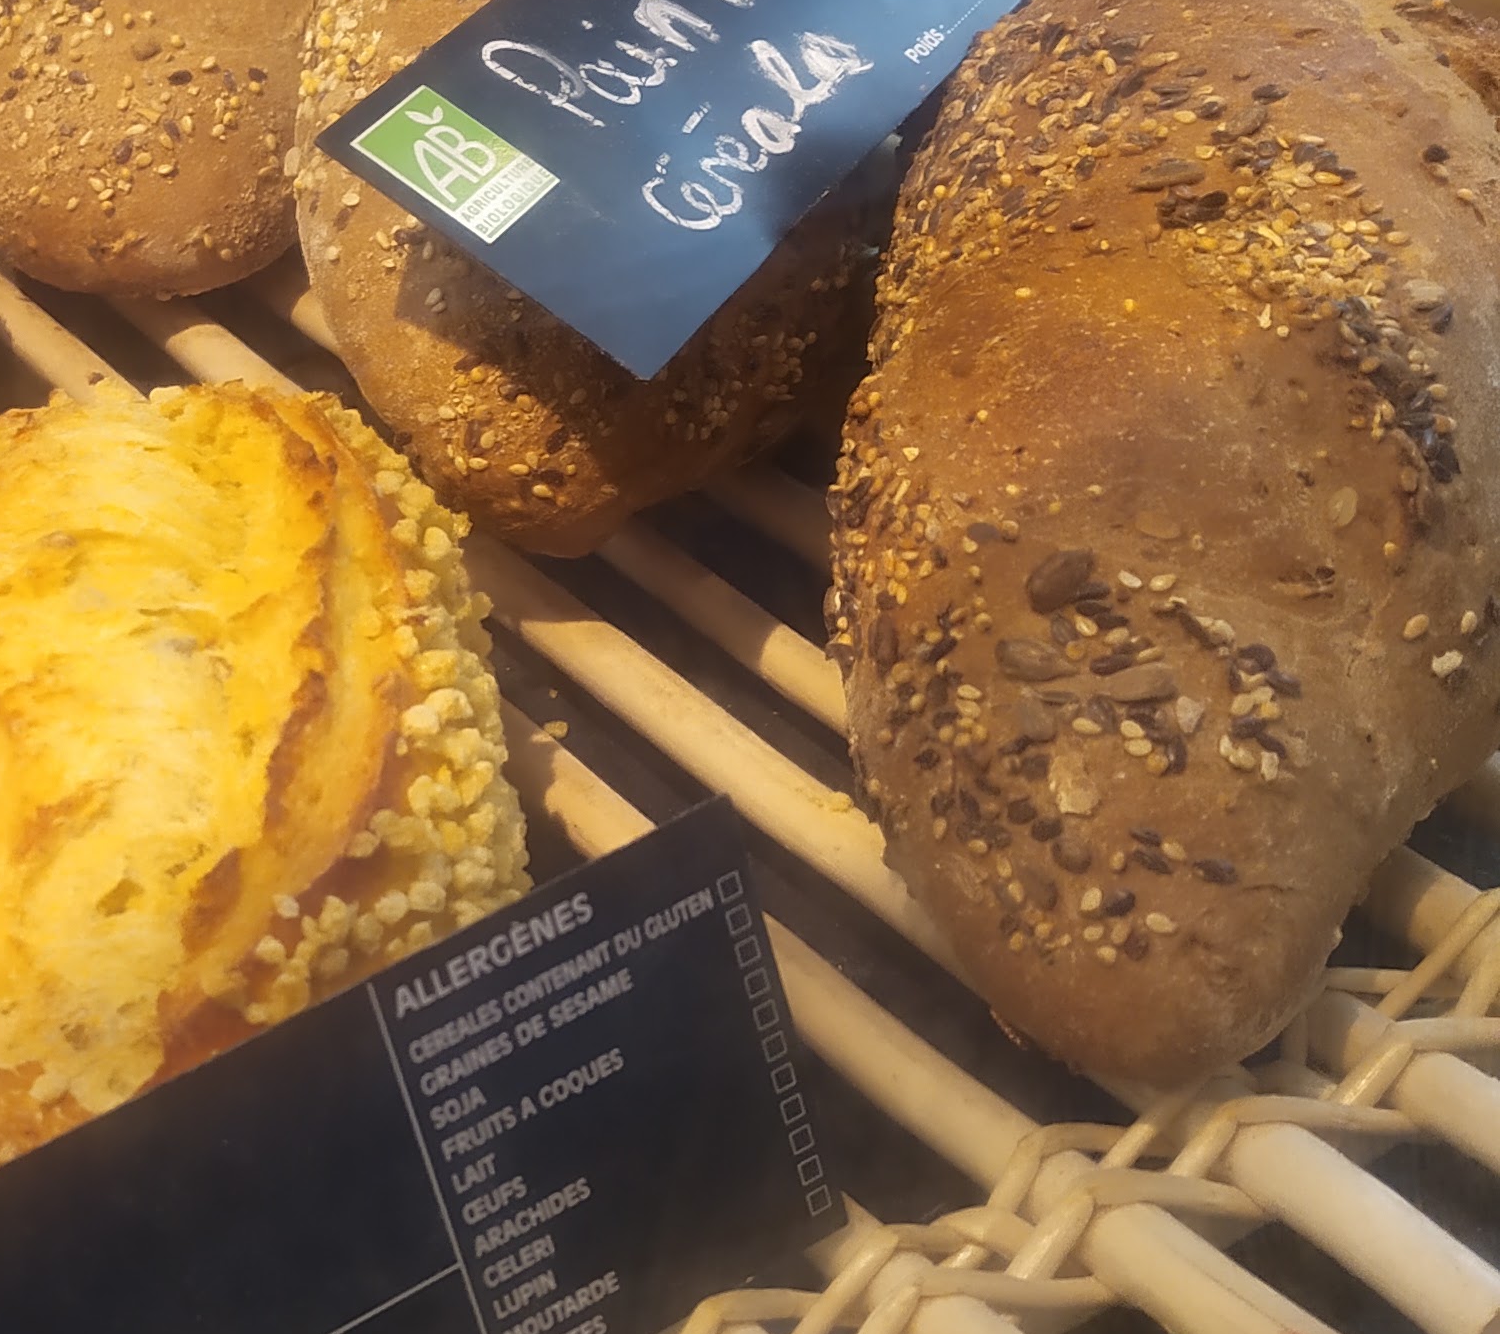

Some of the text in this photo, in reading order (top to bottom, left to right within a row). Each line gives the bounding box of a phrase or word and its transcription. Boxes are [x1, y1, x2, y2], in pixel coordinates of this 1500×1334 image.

[904, 28, 945, 64] Poids
[413, 125, 496, 203] AB
[461, 156, 535, 223] AGRICULTURE
[475, 168, 550, 235] BIOLOGIQUE
[393, 892, 595, 1019] ALLERGÈNES
[407, 887, 715, 1064] CEREALES CONTENANT DU GLUTEN
[418, 967, 634, 1098] GRAINES DE SESAME
[429, 1085, 487, 1131] SOJA
[440, 1105, 517, 1162] FRUITS
[539, 1047, 626, 1111] COQUES
[451, 1155, 498, 1195] LAIT
[473, 1178, 592, 1259] ARACHIDES
[482, 1235, 556, 1290] CELERI
[492, 1270, 558, 1321] LUPIN
